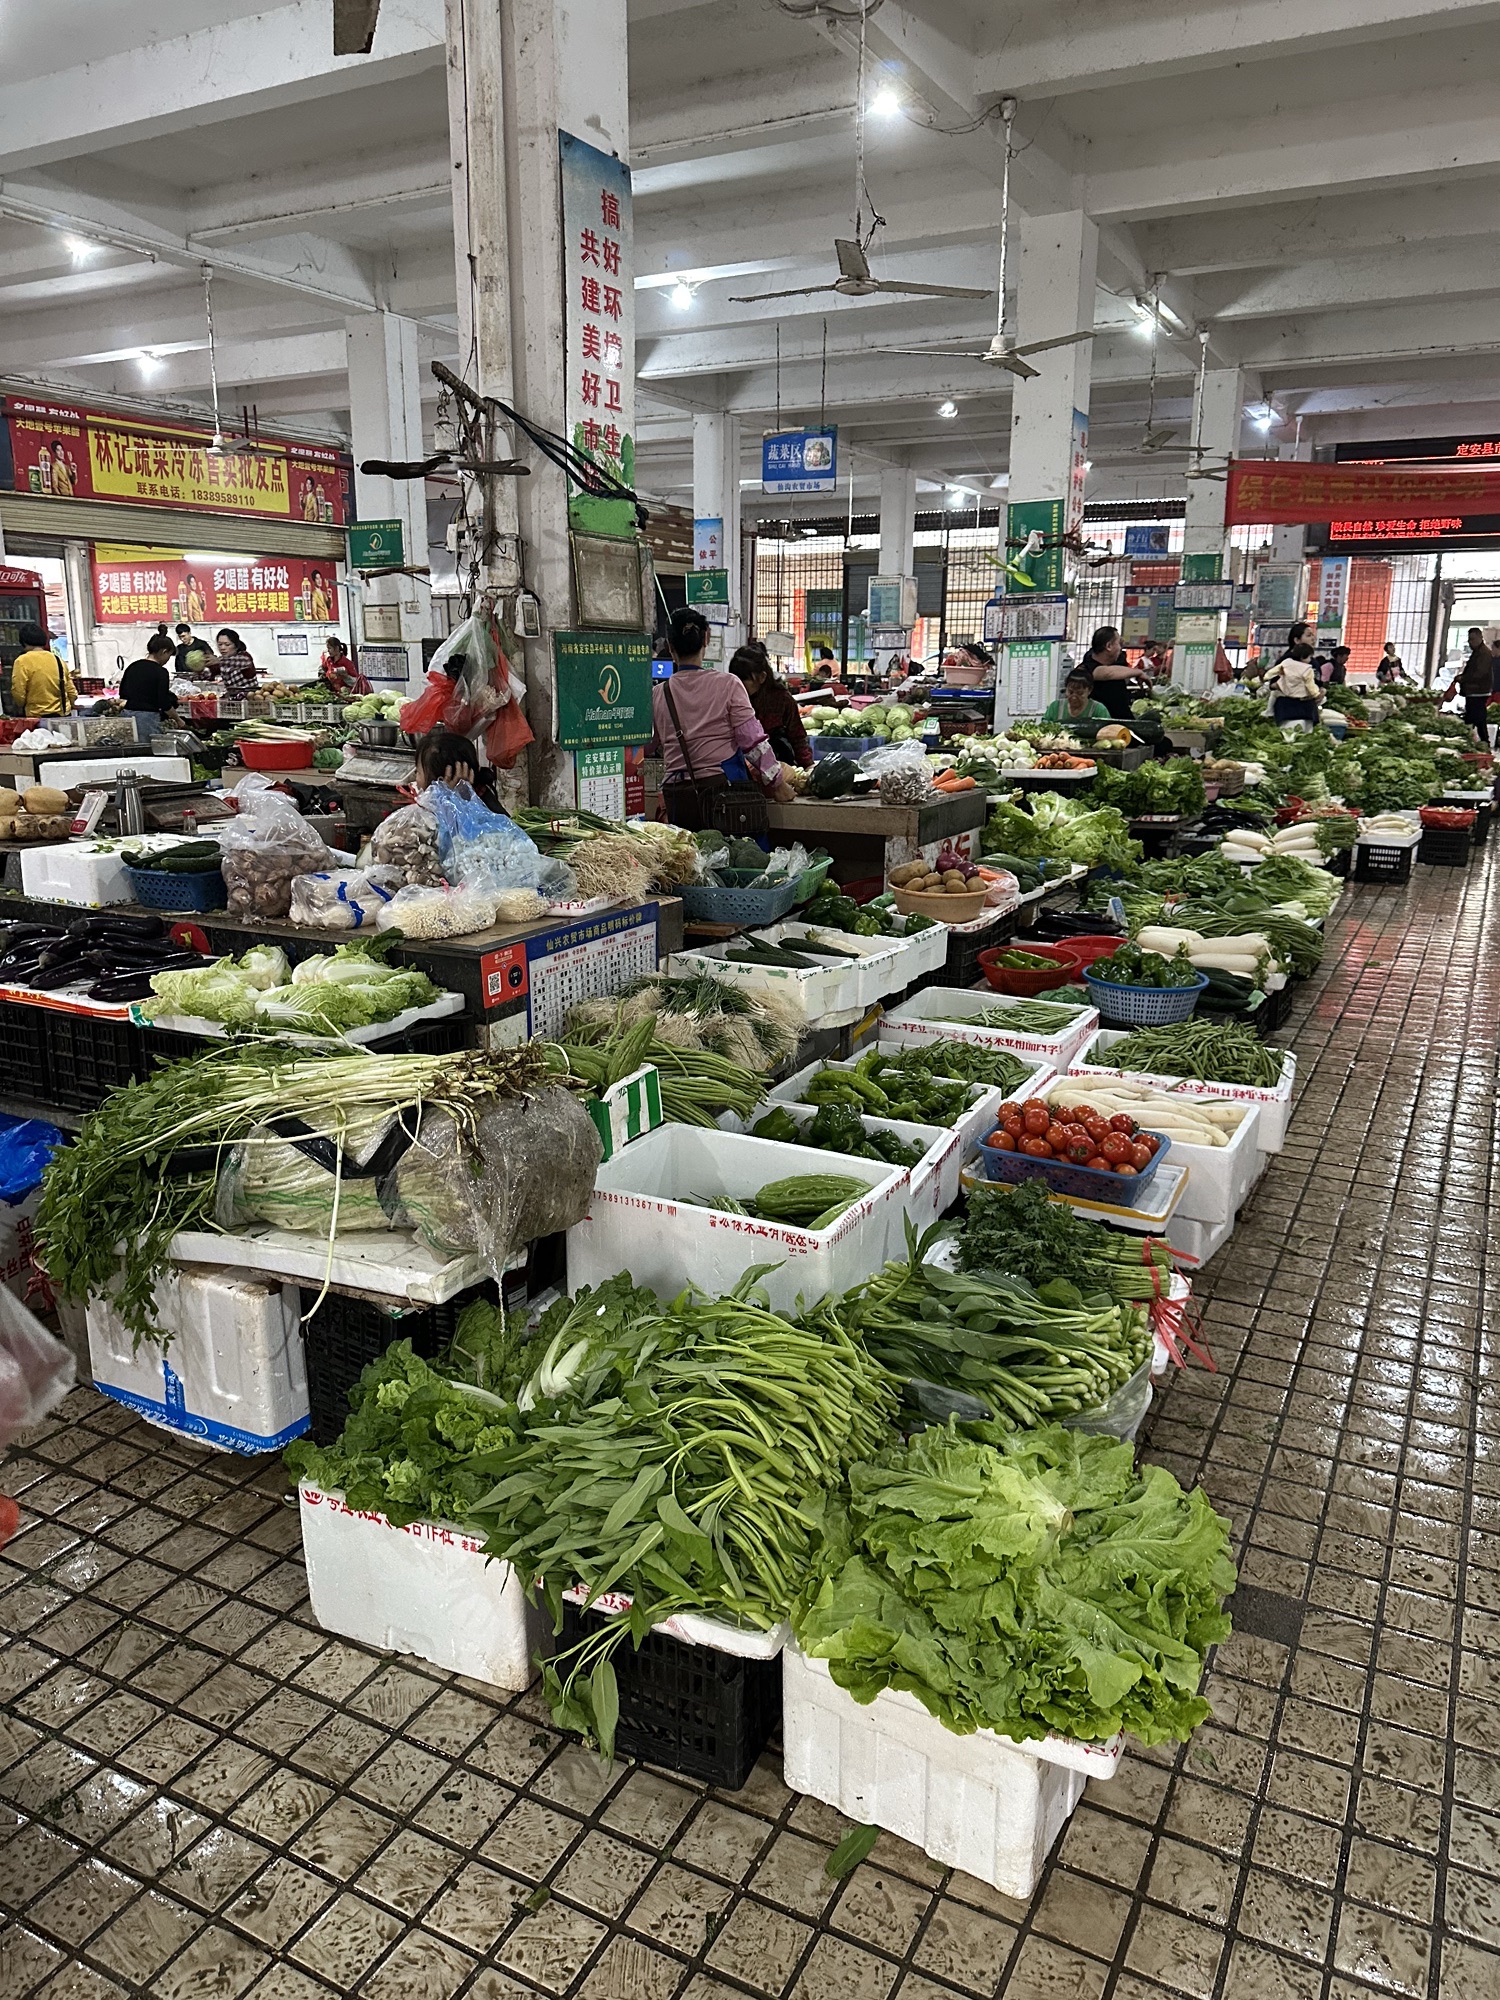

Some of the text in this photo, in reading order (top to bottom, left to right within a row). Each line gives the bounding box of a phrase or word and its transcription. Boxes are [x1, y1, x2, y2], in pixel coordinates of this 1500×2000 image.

[767, 442, 803, 461] 蔬菜区
[98, 570, 168, 595] 多喝醋 有好处
[213, 565, 290, 592] 多喝醋 有好处
[101, 594, 169, 616] 天地壹号苹果醋
[215, 590, 290, 613] 天地壹号苹果醋
[584, 750, 619, 764] 定安菜篮子
[581, 762, 622, 777] 特价菜公示牌
[592, 1190, 653, 1211] 17589131367
